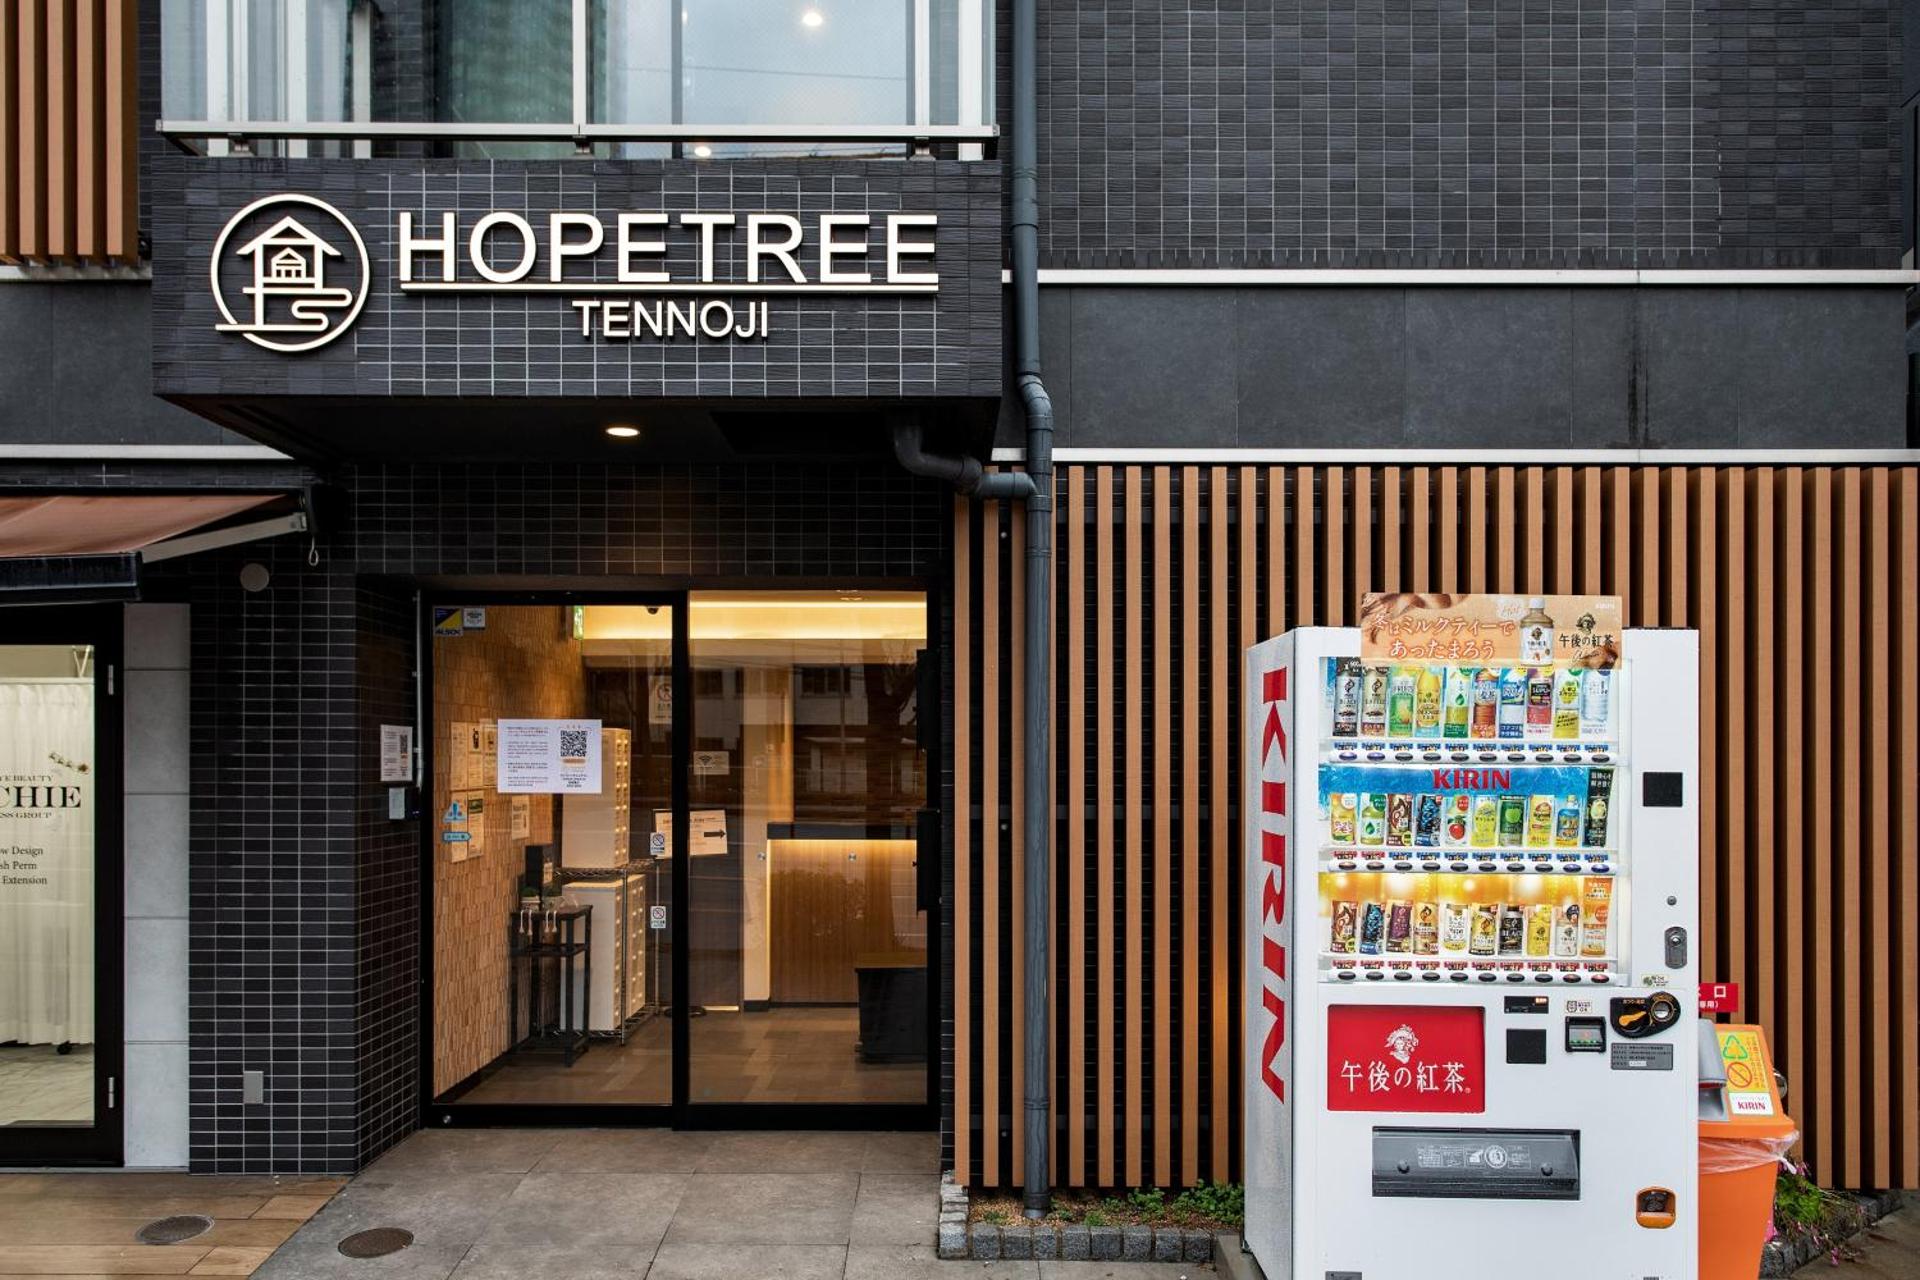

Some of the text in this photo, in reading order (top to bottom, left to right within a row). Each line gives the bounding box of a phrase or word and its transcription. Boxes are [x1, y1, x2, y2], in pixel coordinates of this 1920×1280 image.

[399, 211, 939, 284] HOPETREE
[572, 300, 769, 339] TENNOJI
[1372, 613, 1515, 636] 冬はミルクティーで
[1390, 639, 1496, 660] あったまろう
[1559, 633, 1614, 648] 午後の紅茶
[1432, 768, 1511, 790] KIRIN
[12, 846, 44, 857] Design
[13, 861, 37, 870] Perm
[2, 875, 48, 886] Extension
[1262, 666, 1288, 1103] KIRIN
[1341, 1059, 1465, 1094] 午後の紅茶
[1738, 1101, 1766, 1111] KIRIN
